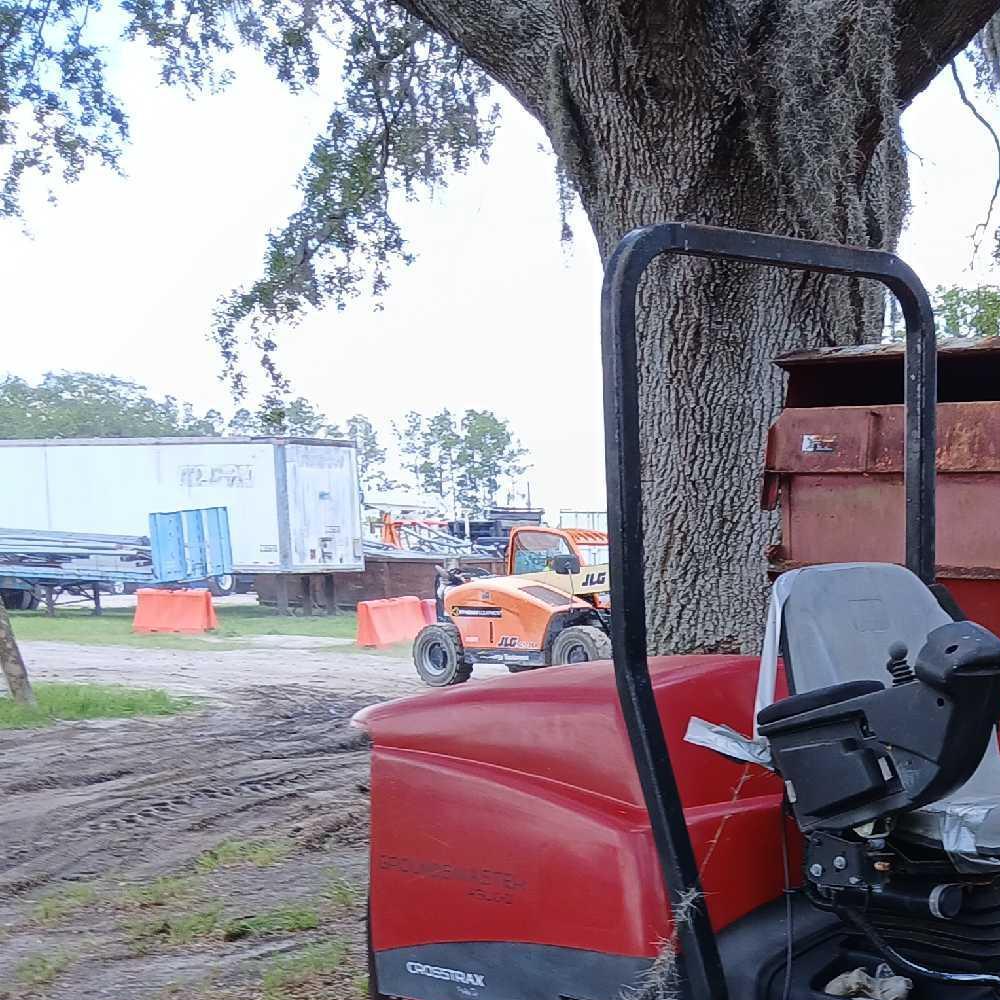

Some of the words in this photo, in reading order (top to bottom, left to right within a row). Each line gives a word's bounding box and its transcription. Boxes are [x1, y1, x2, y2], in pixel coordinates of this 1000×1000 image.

[582, 572, 607, 587] JLG
[498, 636, 517, 648] JLG
[406, 961, 485, 987] CROSSTRAX
